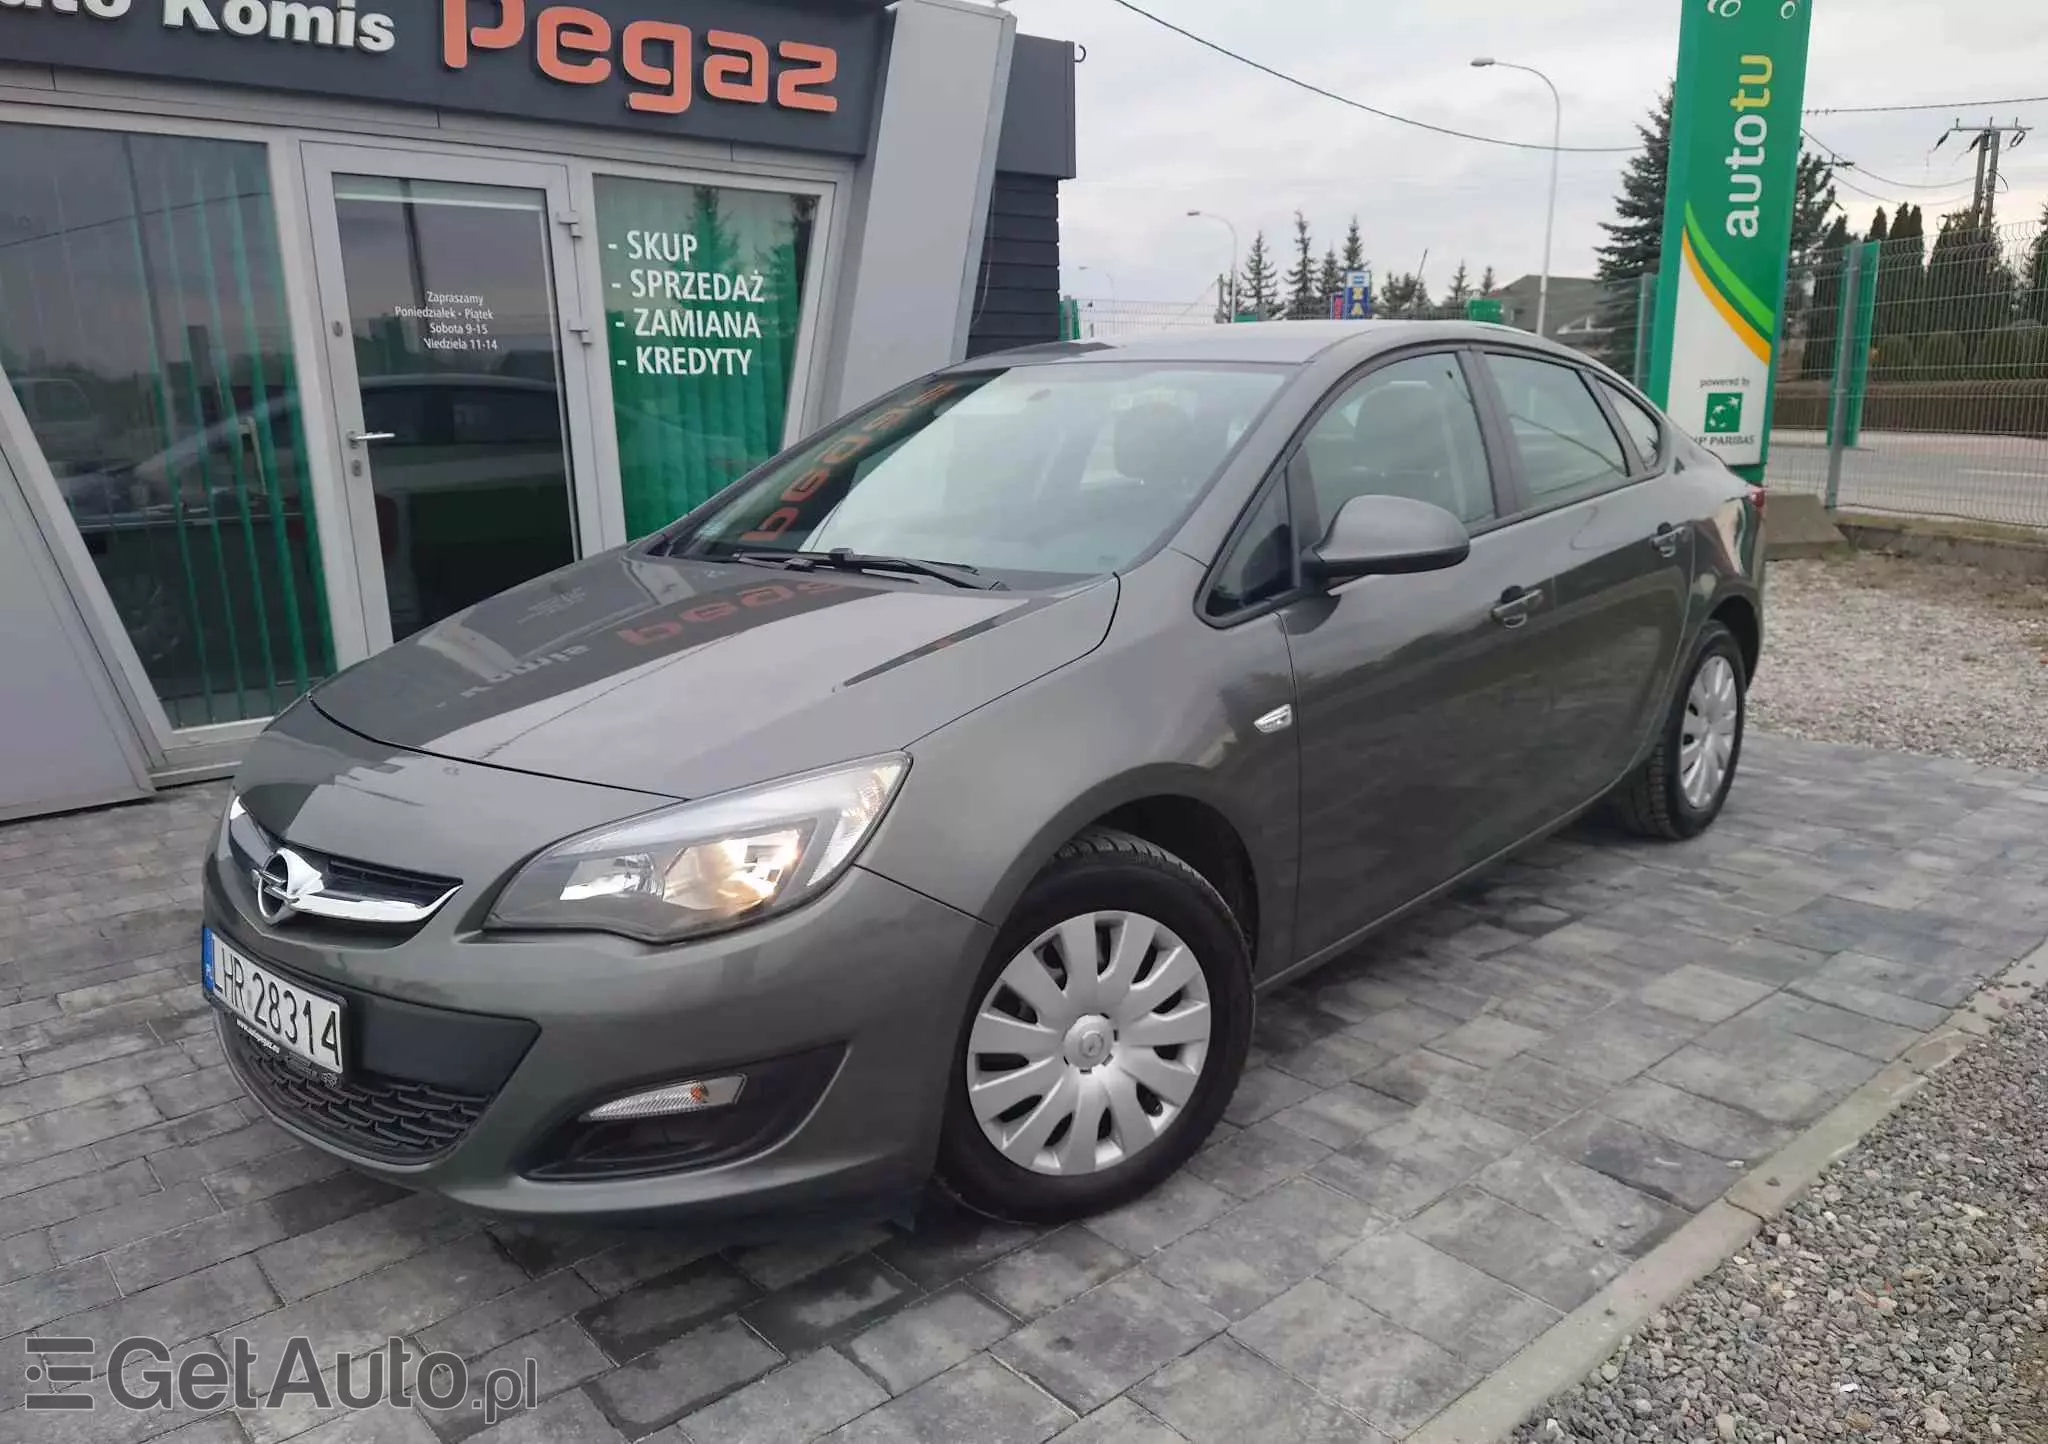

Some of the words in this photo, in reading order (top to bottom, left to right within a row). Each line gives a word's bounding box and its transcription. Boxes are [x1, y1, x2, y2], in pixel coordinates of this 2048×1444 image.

[162, 0, 395, 53] Komis
[1725, 54, 1773, 238] autotu
[627, 230, 698, 263] SKUP
[426, 290, 484, 306] Zapraszamy
[630, 268, 765, 303] SPRZEDAŻ
[394, 305, 457, 319] Poniedziałek
[464, 308, 494, 323] Piątek
[429, 322, 464, 335] Sobota
[465, 323, 488, 335] 9-15
[633, 307, 762, 339] ZAMIANA
[469, 338, 498, 351] 11-14
[636, 345, 753, 376] KREDYTY
[1709, 434, 1756, 446] PARIBAS
[212, 938, 247, 1015] LHR
[252, 971, 341, 1067] 28314
